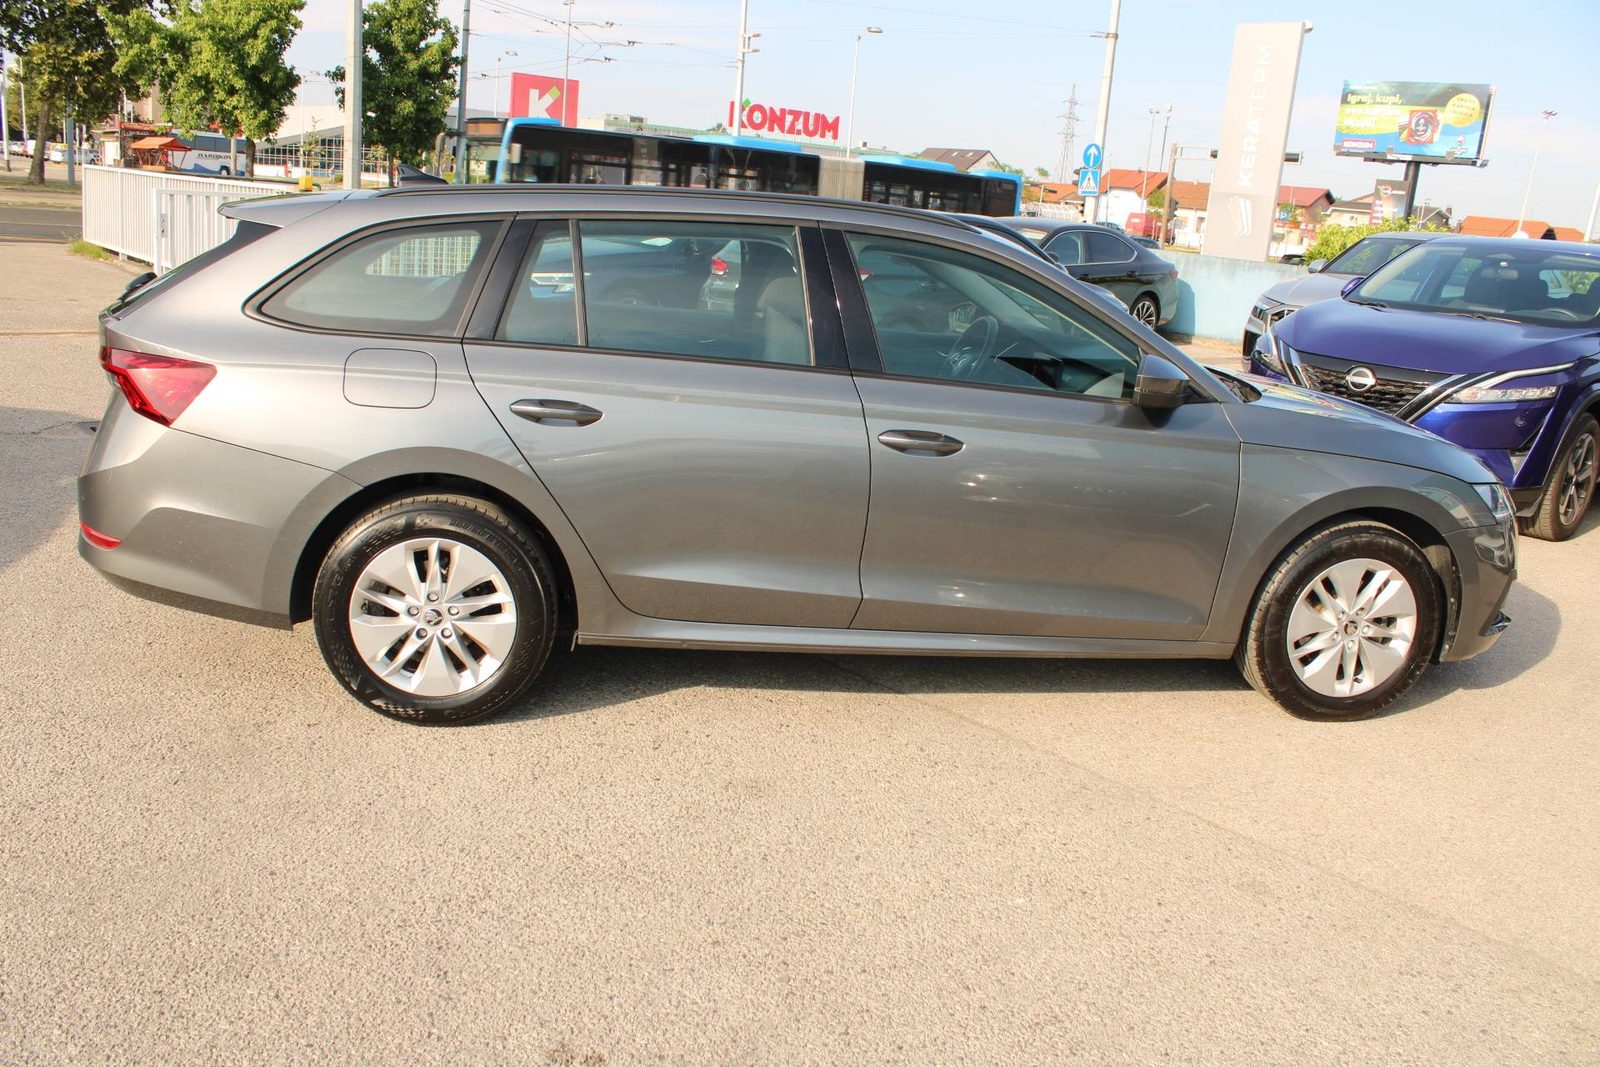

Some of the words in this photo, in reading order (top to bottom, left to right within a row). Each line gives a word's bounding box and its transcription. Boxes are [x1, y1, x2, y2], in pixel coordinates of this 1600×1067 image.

[528, 86, 560, 118] K
[1347, 93, 1374, 104] Igraj,
[1237, 45, 1272, 187] KERATERM
